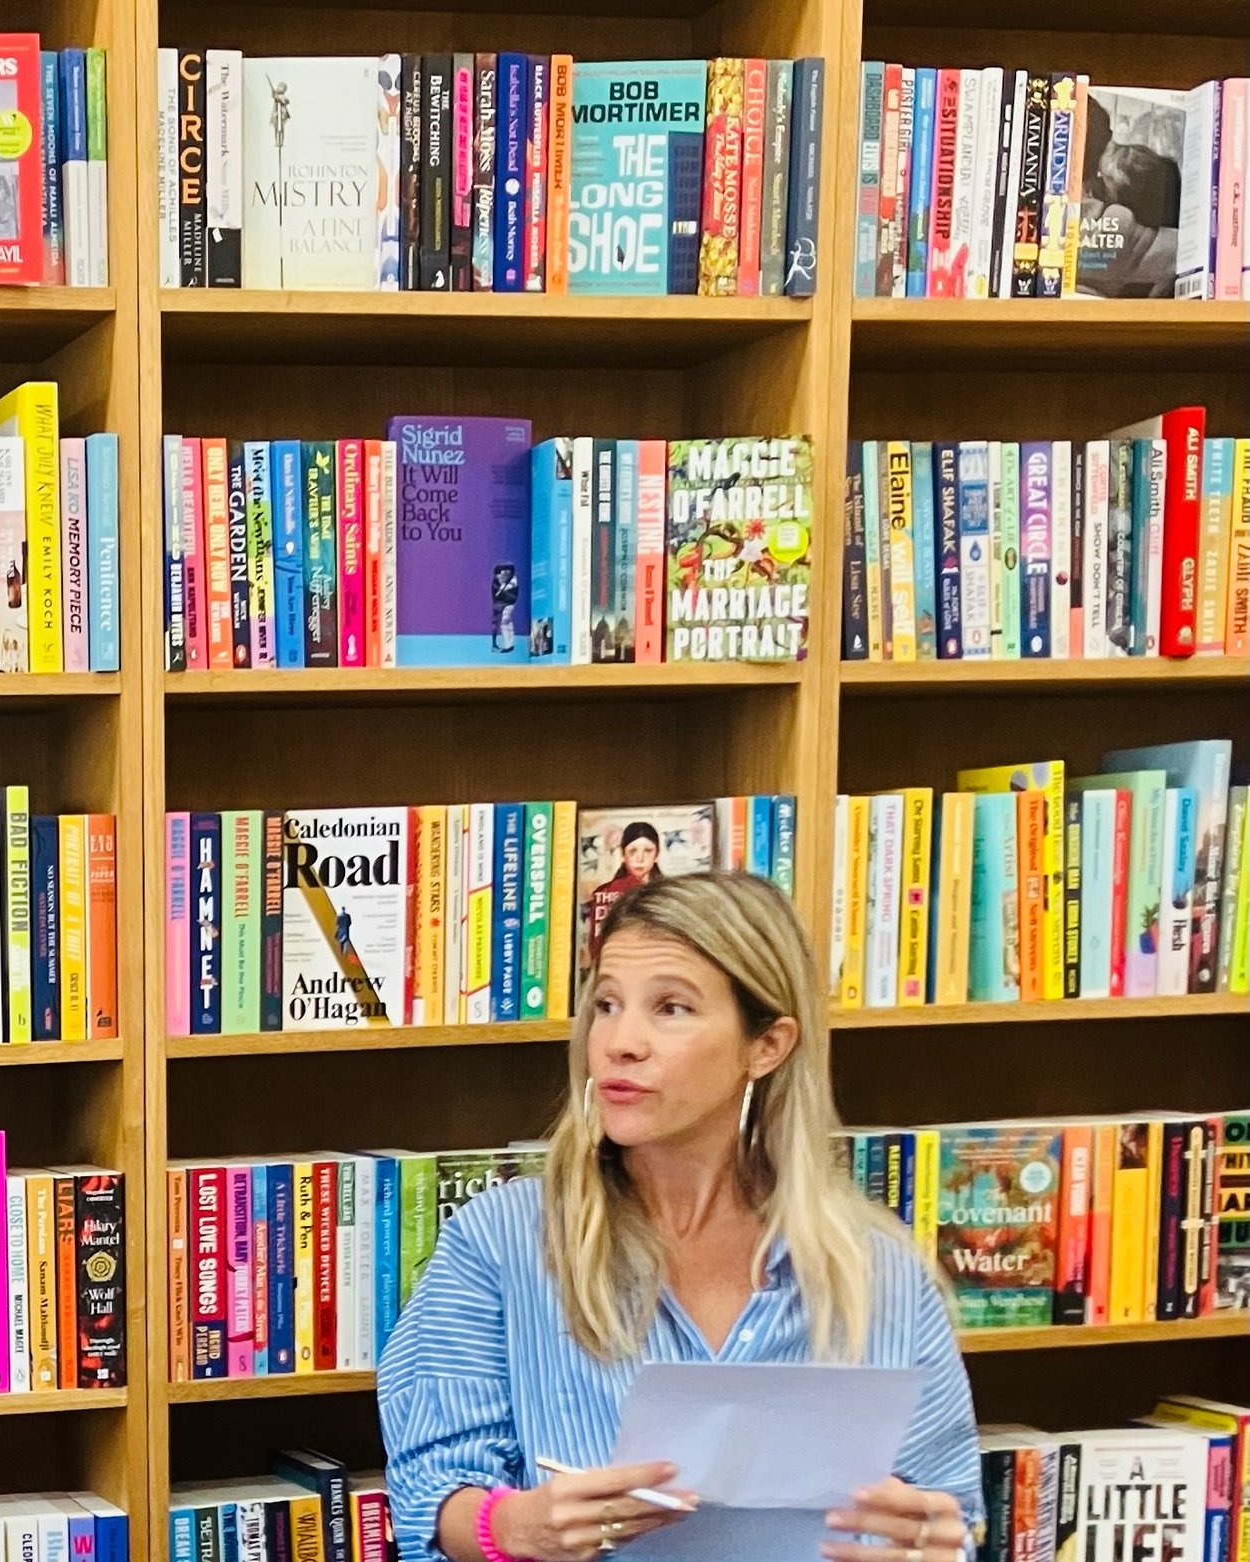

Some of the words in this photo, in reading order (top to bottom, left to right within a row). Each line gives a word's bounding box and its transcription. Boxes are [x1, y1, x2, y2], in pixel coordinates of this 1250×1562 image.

[609, 81, 659, 101] BOB
[570, 101, 700, 124] MORTIMER
[179, 54, 202, 205] CIRCE
[613, 134, 667, 177] THE
[935, 109, 957, 240] SITUATIONSHIP
[252, 180, 368, 207] MISTRY
[567, 180, 664, 210] LONG
[566, 210, 664, 275] SHOE
[402, 424, 462, 445] Sigrid
[402, 444, 465, 464] Nunez
[688, 441, 796, 481] MAGGIE
[232, 466, 240, 492] THE
[402, 467, 417, 484] It
[423, 466, 458, 484] Will
[1028, 452, 1048, 509] GREAT
[402, 487, 458, 503] Come
[673, 484, 809, 523] O'FARRELL
[889, 451, 909, 530] Elaine
[402, 504, 450, 522] Back
[231, 493, 246, 582] GARDEN
[402, 526, 419, 541] to
[422, 525, 462, 541] You
[1028, 513, 1048, 576] CIRCLE
[702, 558, 733, 582] THE
[672, 583, 808, 621] MARRIAGE
[673, 624, 804, 660] PORTRAIT
[10, 813, 27, 848] BAD
[283, 817, 401, 840] Caledonian
[283, 841, 401, 889] Road
[530, 814, 547, 924] OVERSPILL
[10, 860, 28, 932] FICTION
[198, 838, 214, 1009] HAMNET
[293, 973, 386, 995] Andrew
[289, 998, 387, 1024] O'Hagan
[198, 1173, 217, 1213] LOST
[84, 1221, 116, 1235] Hilary
[936, 1203, 1051, 1226] Covenant
[81, 1233, 120, 1246] Mantel
[198, 1216, 217, 1254] LOVE
[953, 1248, 1028, 1273] Water
[90, 1288, 113, 1301] Wolf
[198, 1258, 217, 1316] SONGS
[91, 1302, 113, 1314] Hall
[1130, 1456, 1145, 1480] A
[1087, 1484, 1187, 1520] LITTLE
